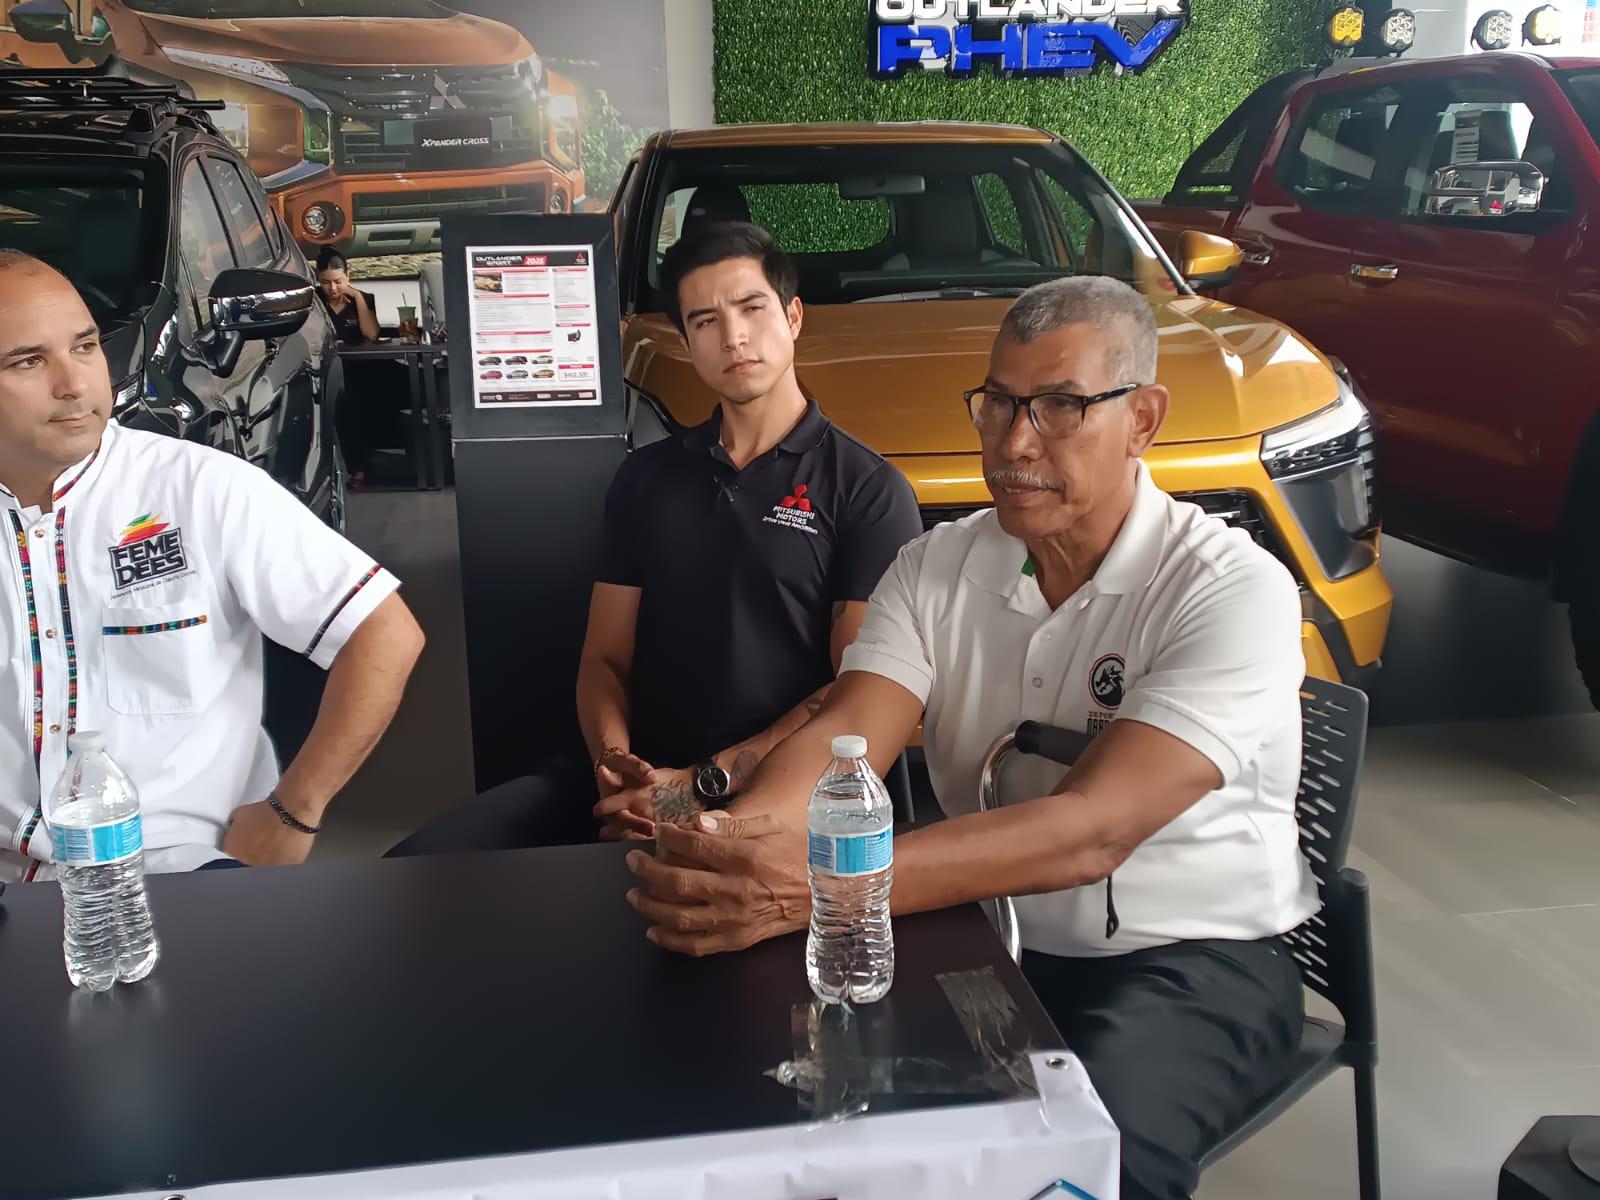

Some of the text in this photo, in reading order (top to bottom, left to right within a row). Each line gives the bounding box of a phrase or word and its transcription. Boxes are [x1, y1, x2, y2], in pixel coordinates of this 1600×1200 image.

[877, 21, 1184, 71] PHEV
[421, 137, 490, 147] XPANDER CROSS
[773, 505, 815, 520] MITSUBISHI
[776, 512, 808, 525] MOTORS
[111, 531, 181, 568] FEME
[115, 549, 185, 587] DEES
